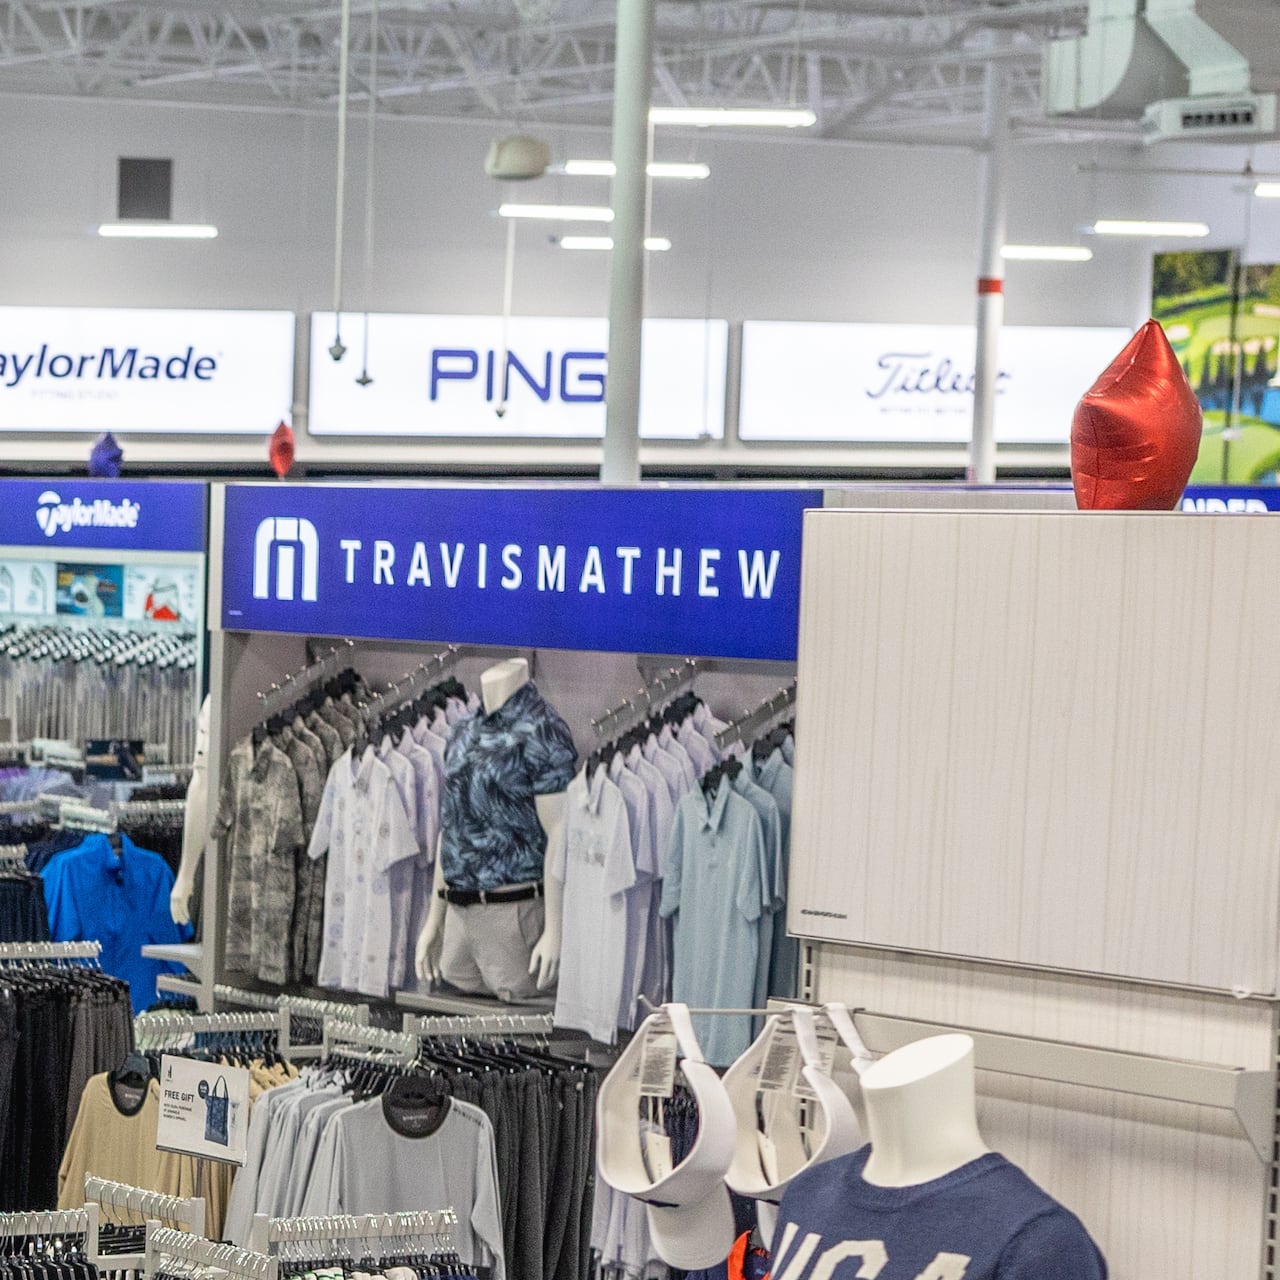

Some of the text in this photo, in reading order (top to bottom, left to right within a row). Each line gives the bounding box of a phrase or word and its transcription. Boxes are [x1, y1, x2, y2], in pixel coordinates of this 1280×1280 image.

[430, 347, 607, 403] PING
[339, 538, 782, 600] TRAVISMATHEW
[164, 1089, 195, 1103] FREE GIFT
